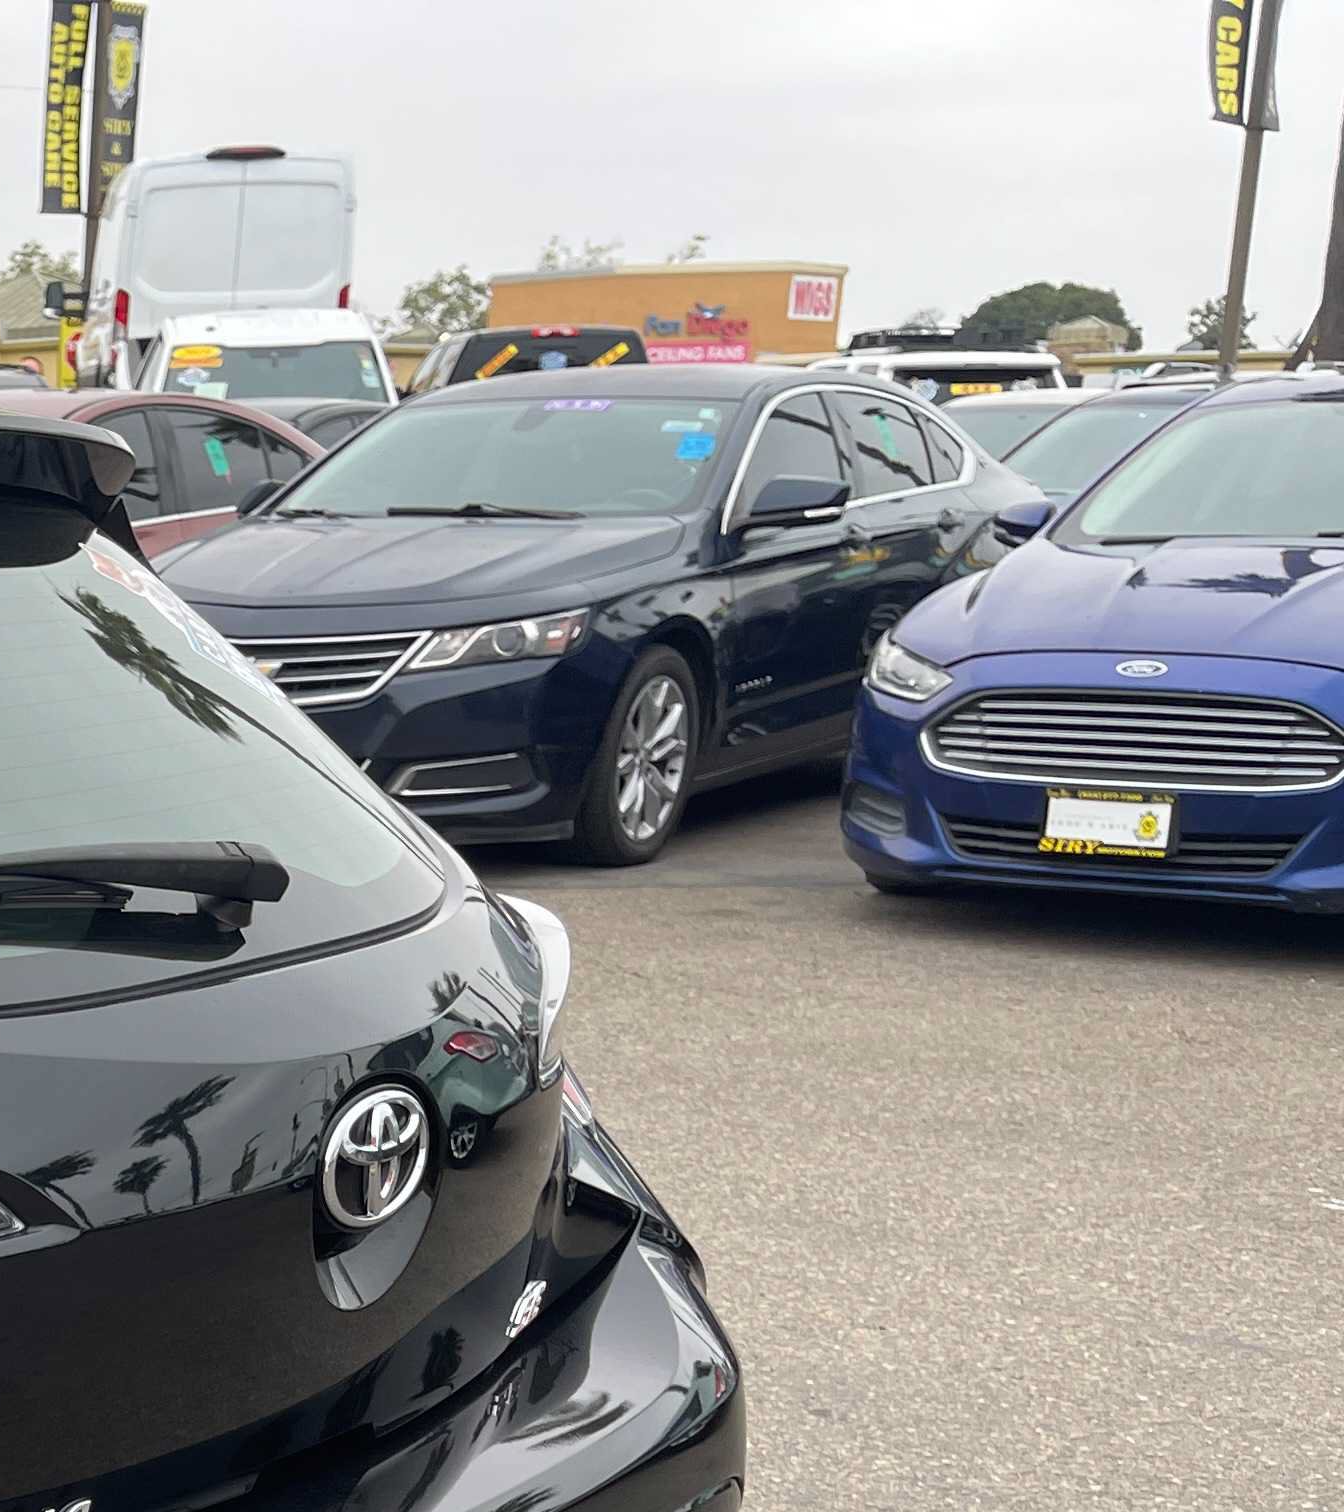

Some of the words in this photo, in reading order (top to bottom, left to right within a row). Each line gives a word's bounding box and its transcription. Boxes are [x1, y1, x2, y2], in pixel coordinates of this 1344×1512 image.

[1215, 15, 1242, 117] CARS
[62, 84, 81, 209] SERVICE
[793, 280, 834, 318] WIGS
[1039, 837, 1104, 855] SIRY
